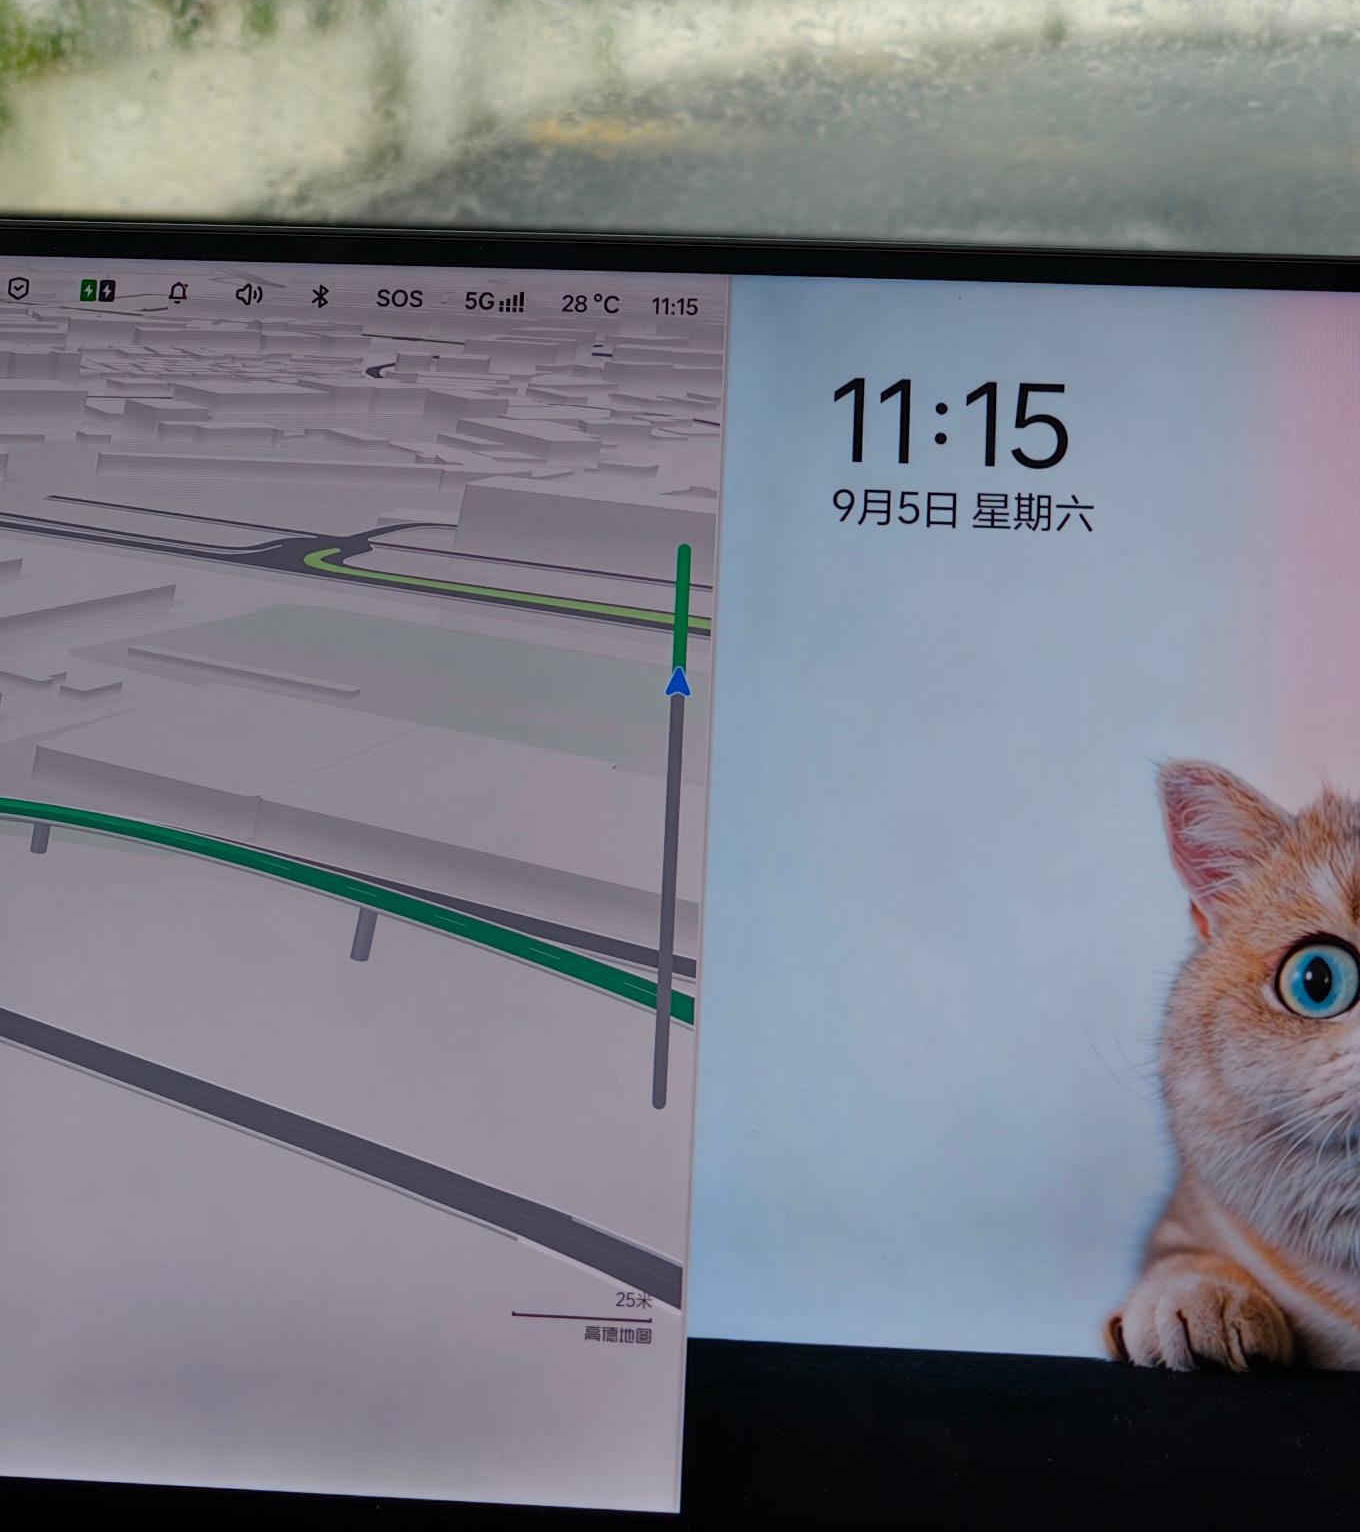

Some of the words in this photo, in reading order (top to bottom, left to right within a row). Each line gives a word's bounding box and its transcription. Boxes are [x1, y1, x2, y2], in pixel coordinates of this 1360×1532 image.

[377, 289, 423, 307] SOS
[465, 292, 494, 310] 5G
[652, 298, 698, 315] 11:15
[834, 378, 1068, 469] 11:15
[833, 489, 956, 528] 9月5日
[973, 493, 1094, 532] 星期六
[616, 1292, 652, 1309] 25米
[585, 1326, 652, 1344] 高德地图
